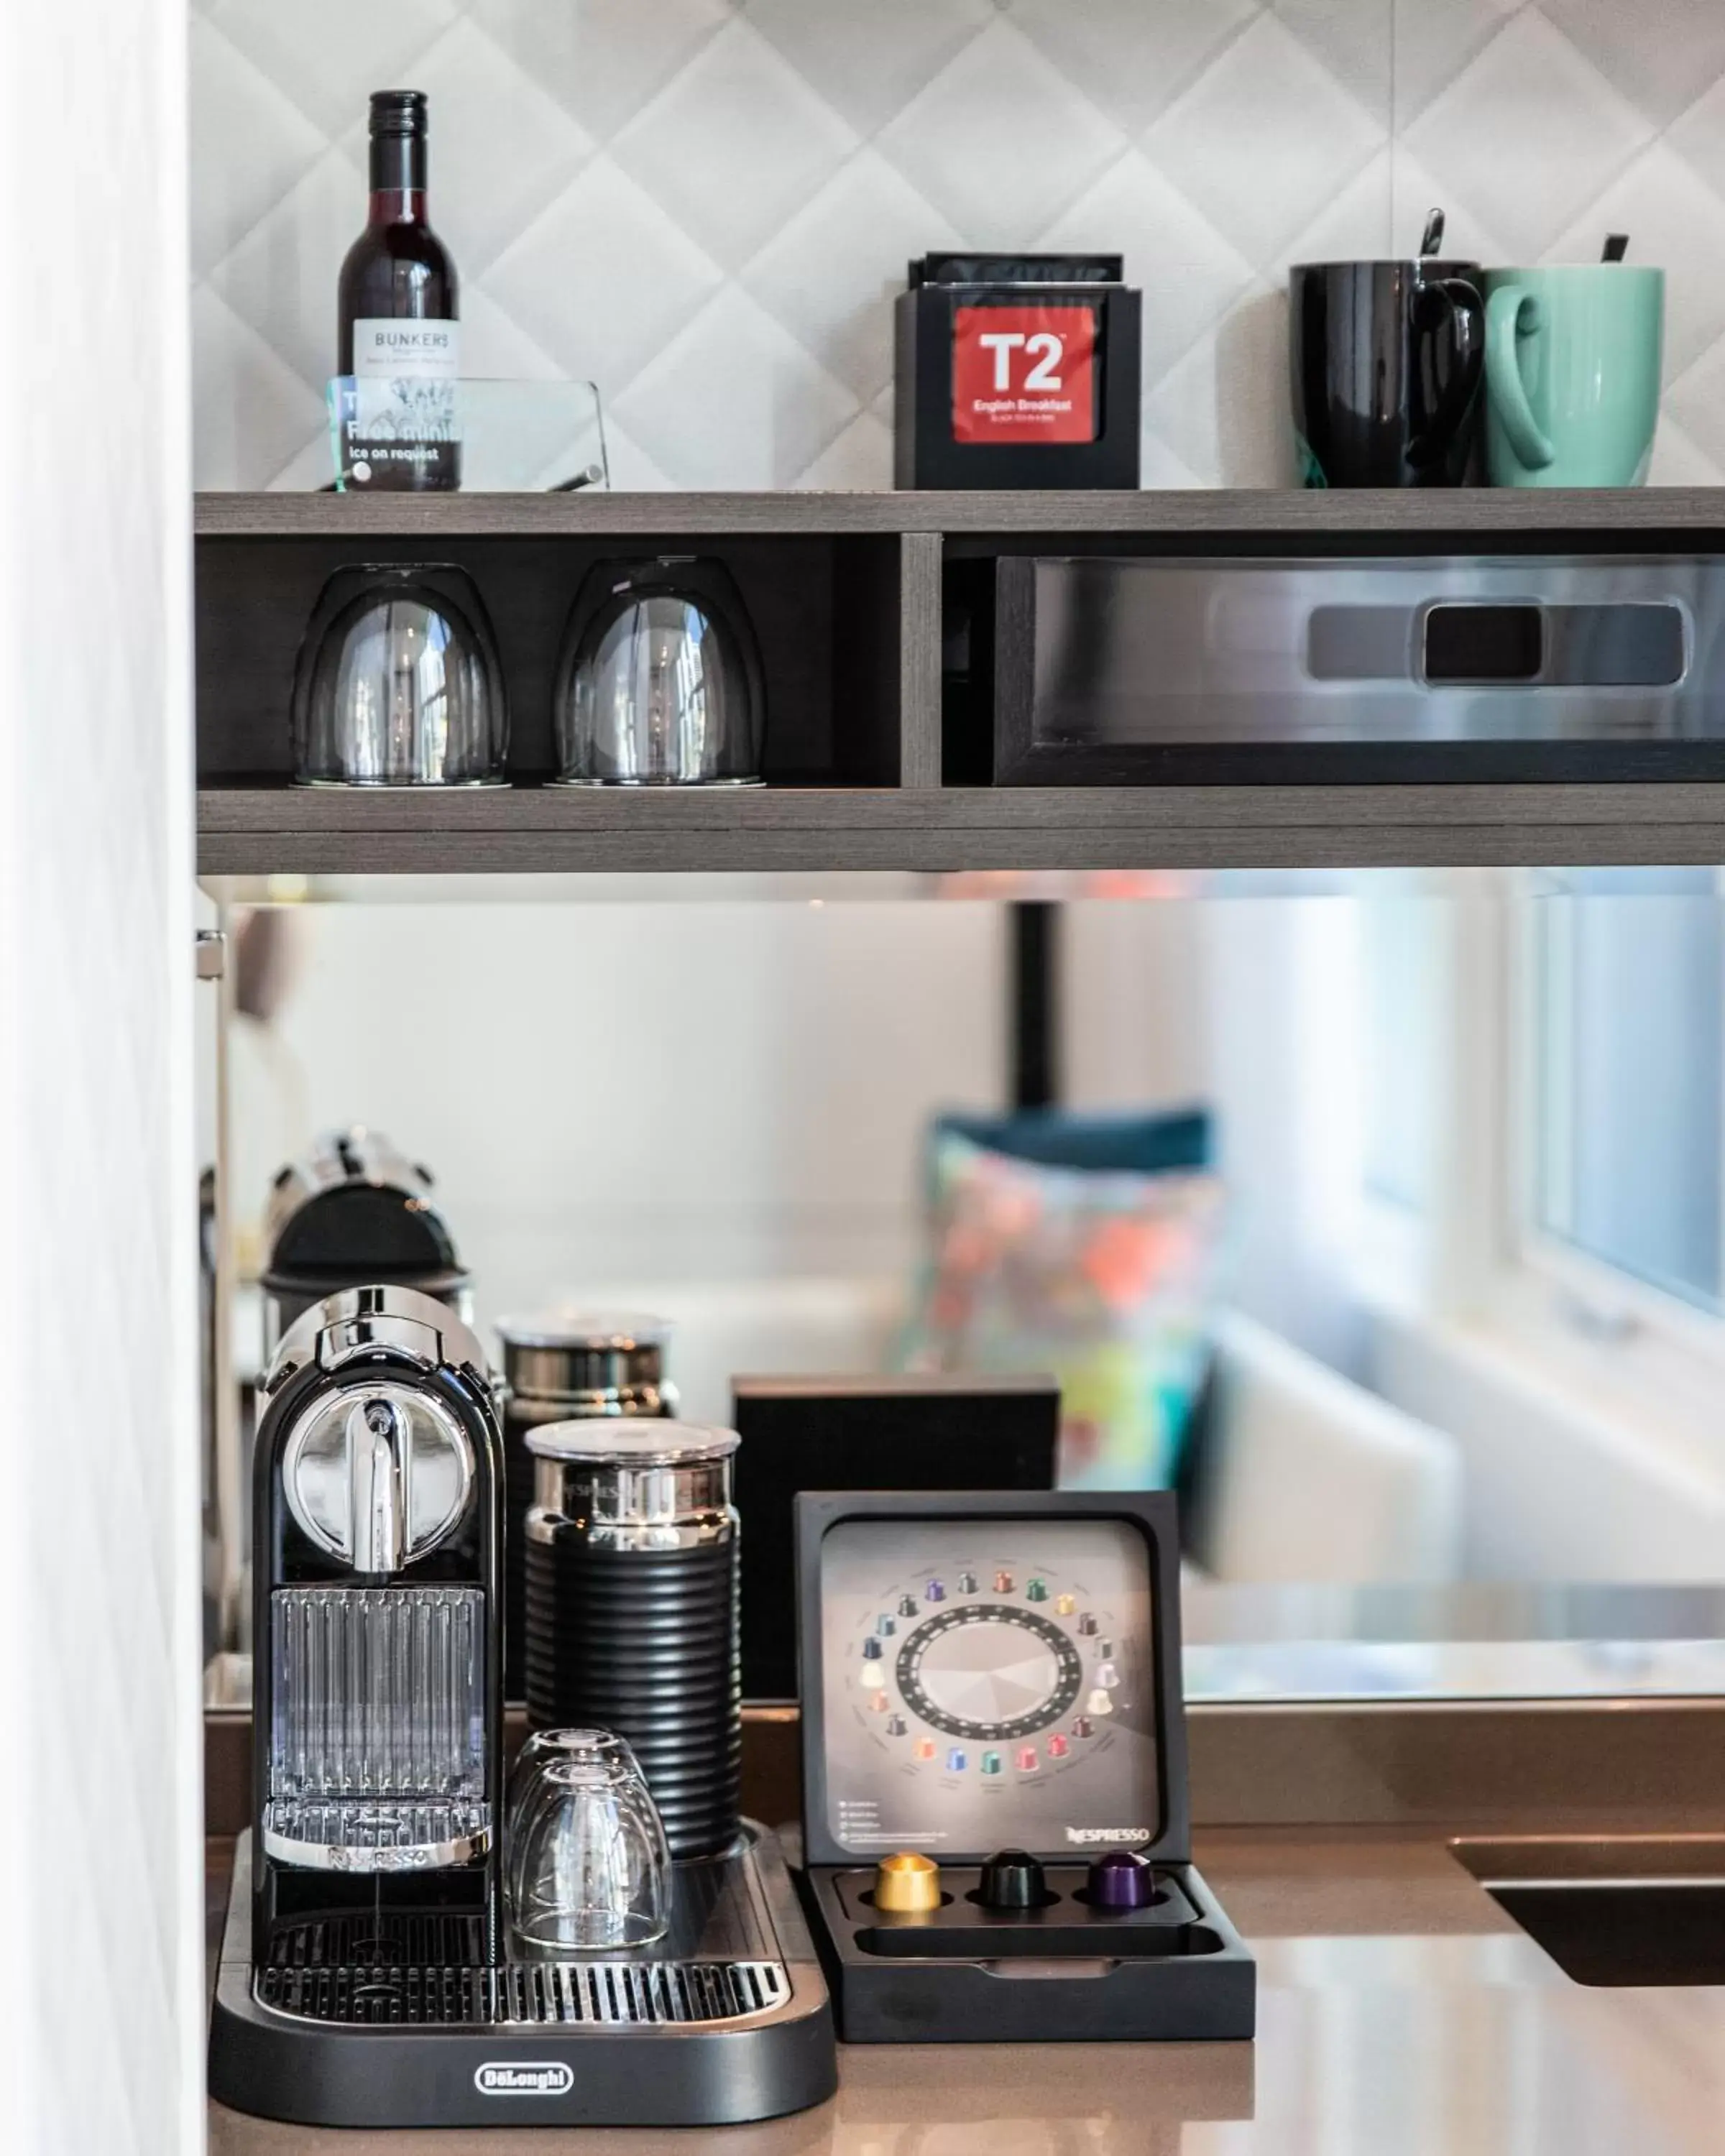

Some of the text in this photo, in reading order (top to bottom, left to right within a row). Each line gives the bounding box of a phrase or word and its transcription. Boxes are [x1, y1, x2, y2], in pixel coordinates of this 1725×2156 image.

[979, 333, 1063, 392] T2
[974, 399, 1072, 413] English Breakfast
[372, 448, 388, 459] on
[390, 448, 440, 461] request
[1064, 1826, 1151, 1844] NESPRESSO
